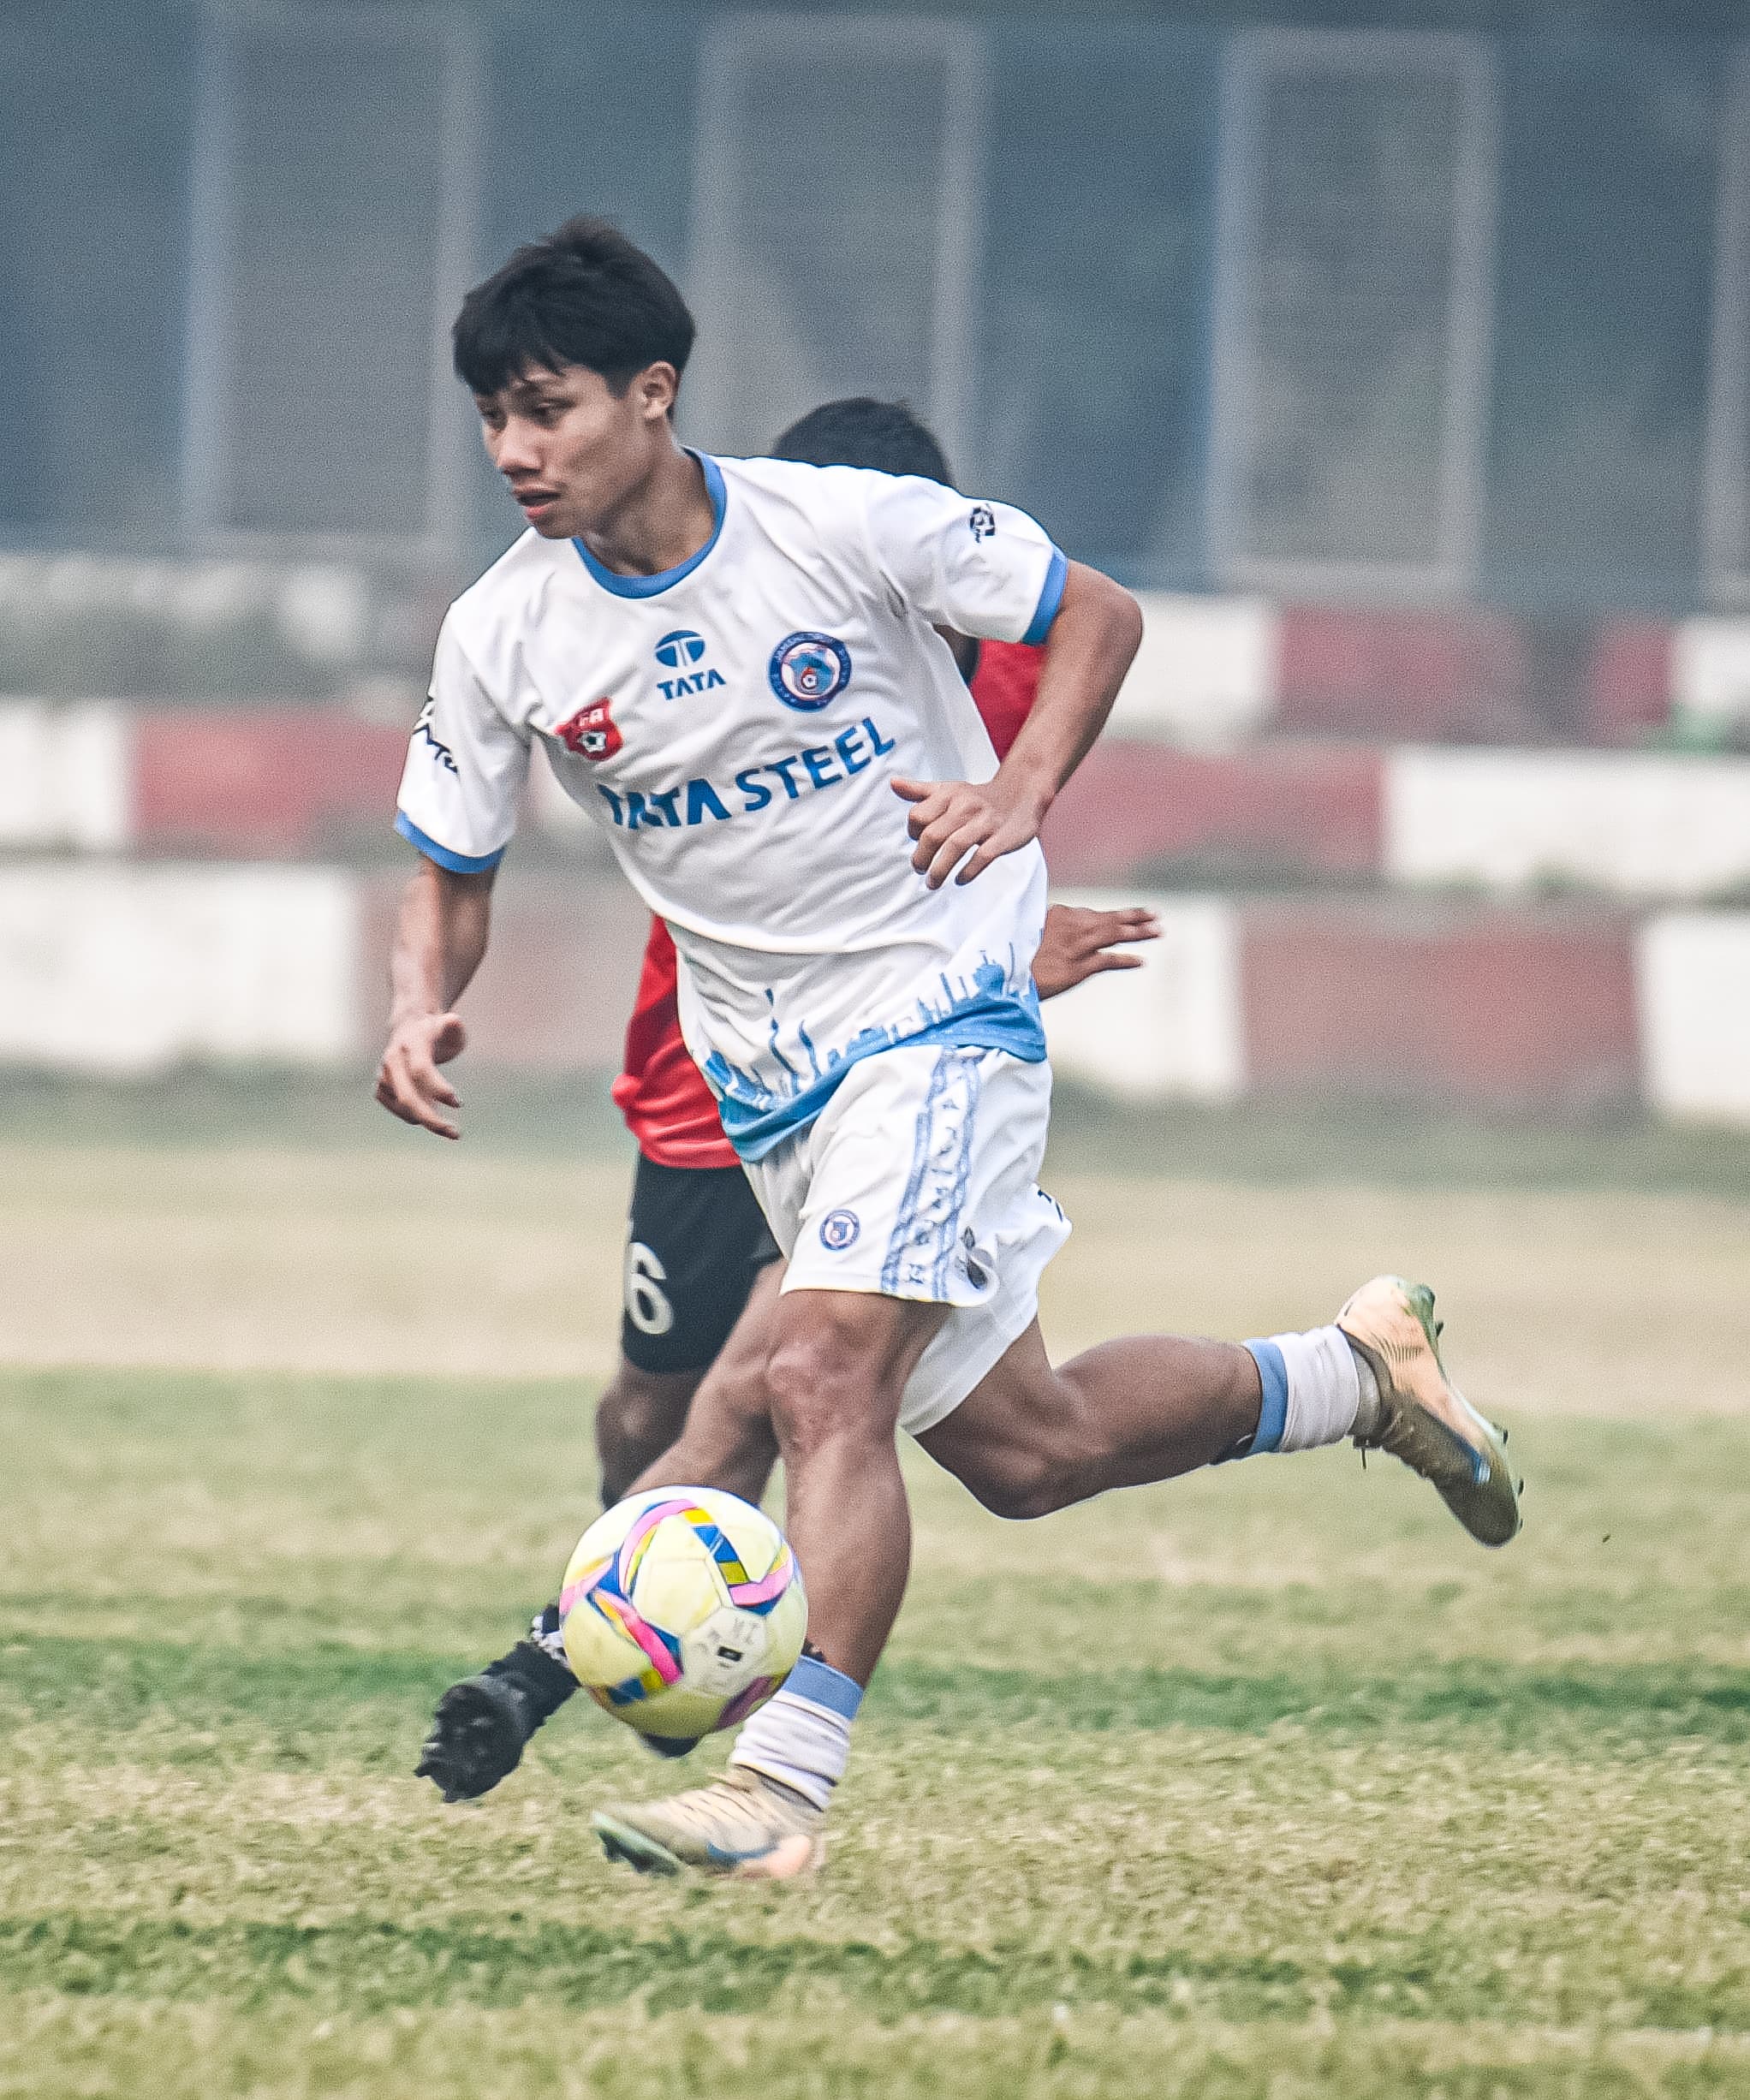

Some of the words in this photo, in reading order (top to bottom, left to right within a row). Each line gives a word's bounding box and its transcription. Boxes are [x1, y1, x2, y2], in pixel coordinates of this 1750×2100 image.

[657, 669, 726, 700] TATA
[598, 778, 732, 830] TATA
[735, 717, 896, 812] STEEL
[625, 1242, 674, 1335] 6
